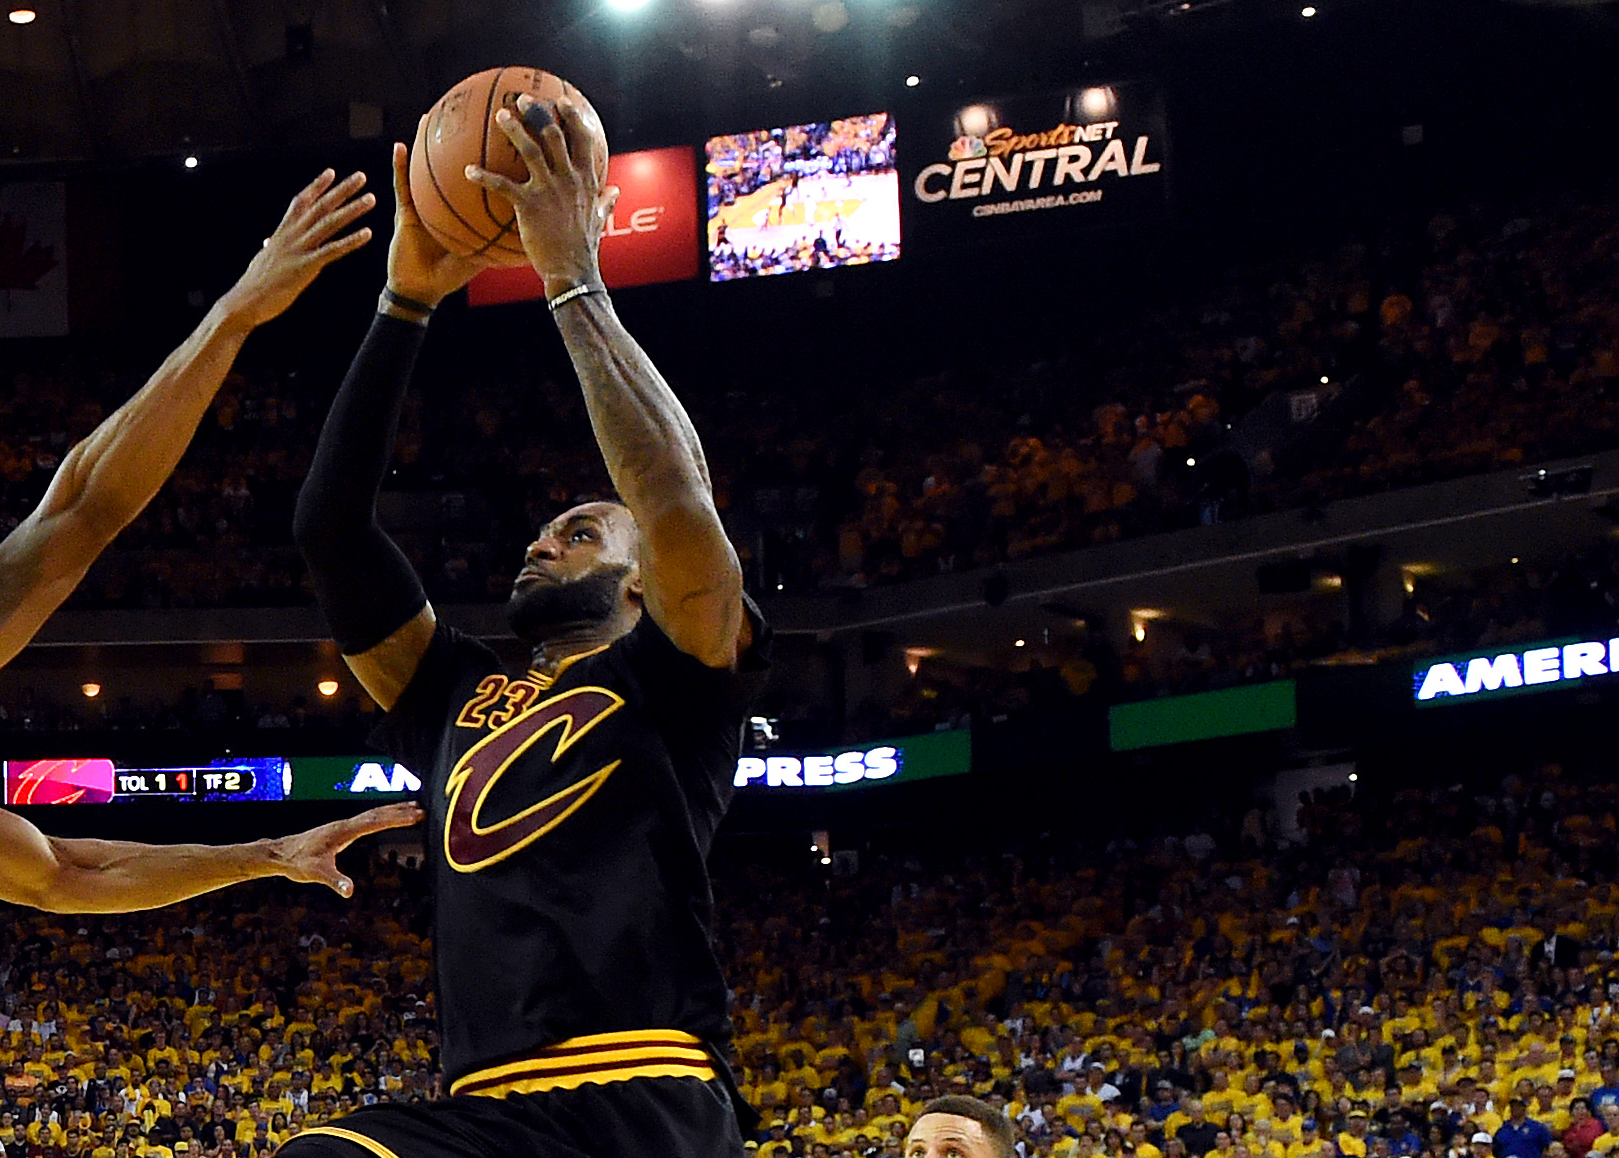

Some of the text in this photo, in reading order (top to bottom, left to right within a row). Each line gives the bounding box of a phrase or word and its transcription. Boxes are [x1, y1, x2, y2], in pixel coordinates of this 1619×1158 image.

[914, 136, 1161, 203] CENTRAL
[455, 674, 540, 731] 23
[119, 773, 188, 792] TOL 1 1
[203, 773, 240, 791] TF 2
